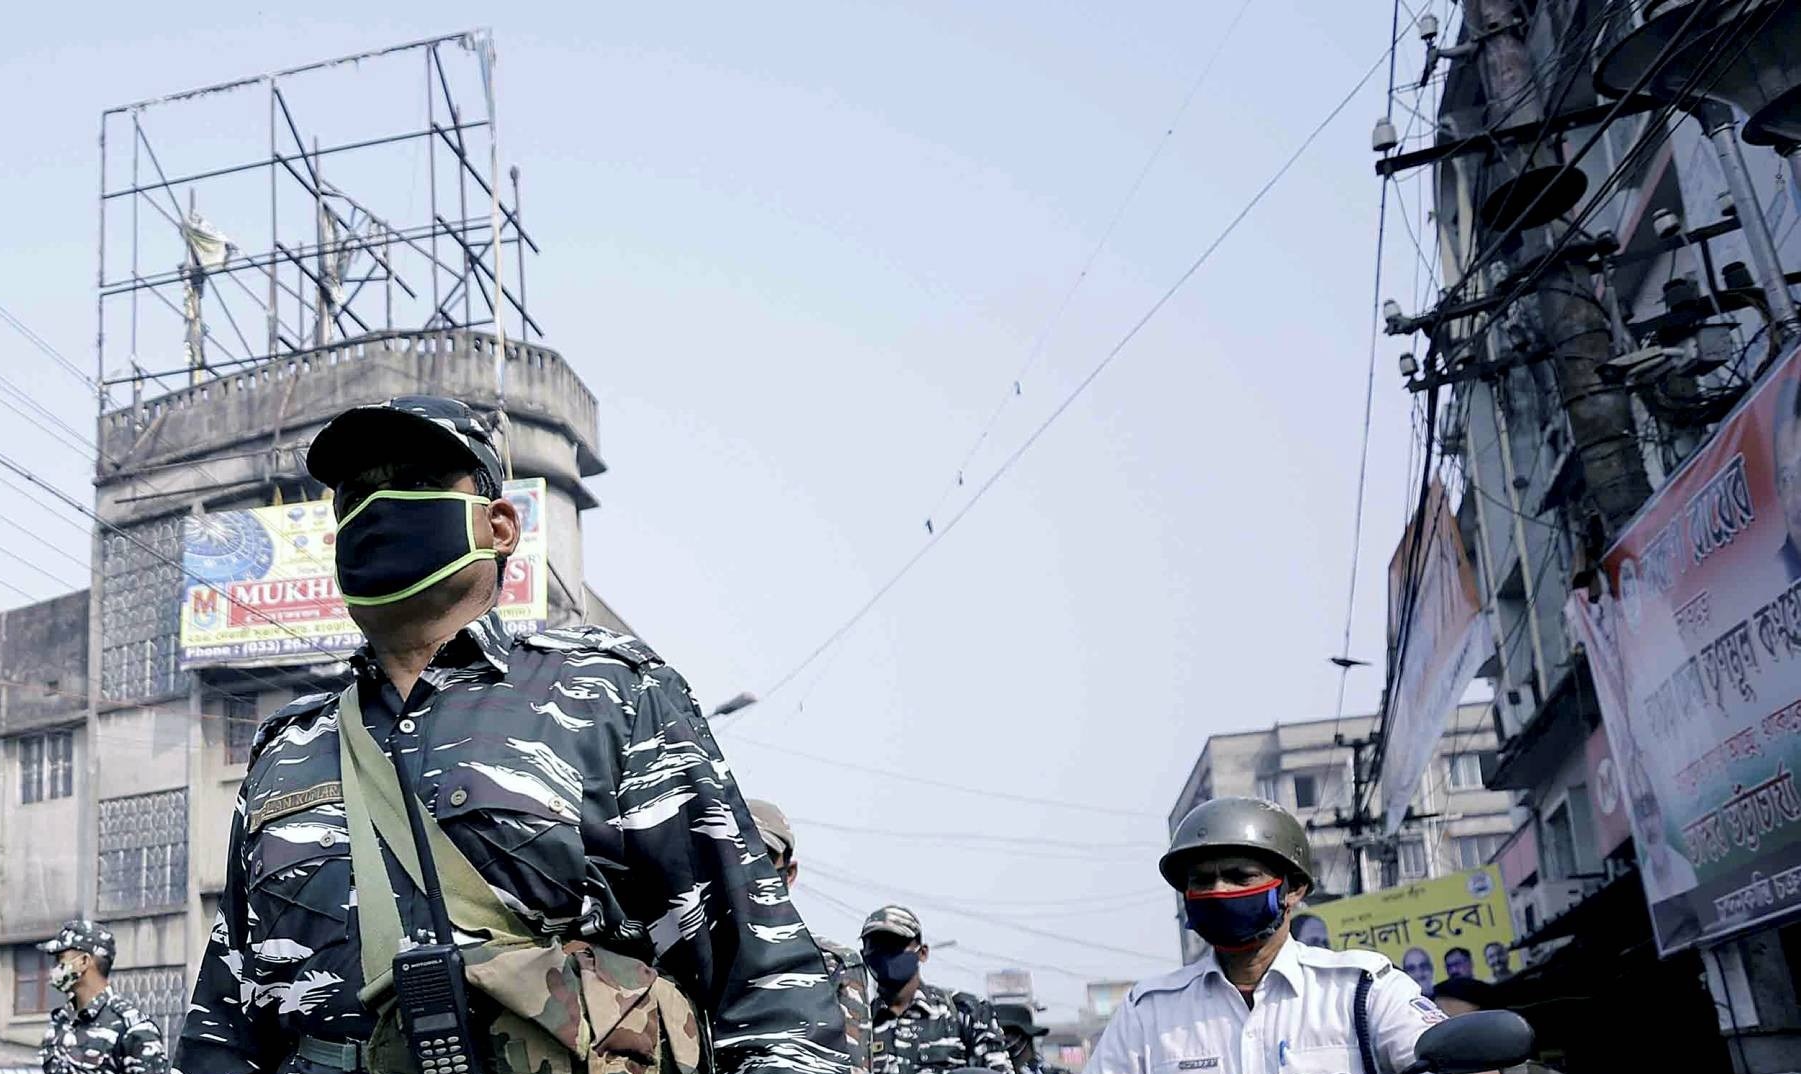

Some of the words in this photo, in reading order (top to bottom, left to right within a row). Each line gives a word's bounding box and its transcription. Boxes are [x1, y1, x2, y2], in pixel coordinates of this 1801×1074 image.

[185, 645, 232, 658] Phone
[245, 639, 281, 655] (033)
[1700, 620, 1758, 713] তৃণমূল
[1338, 918, 1411, 950] খেলা
